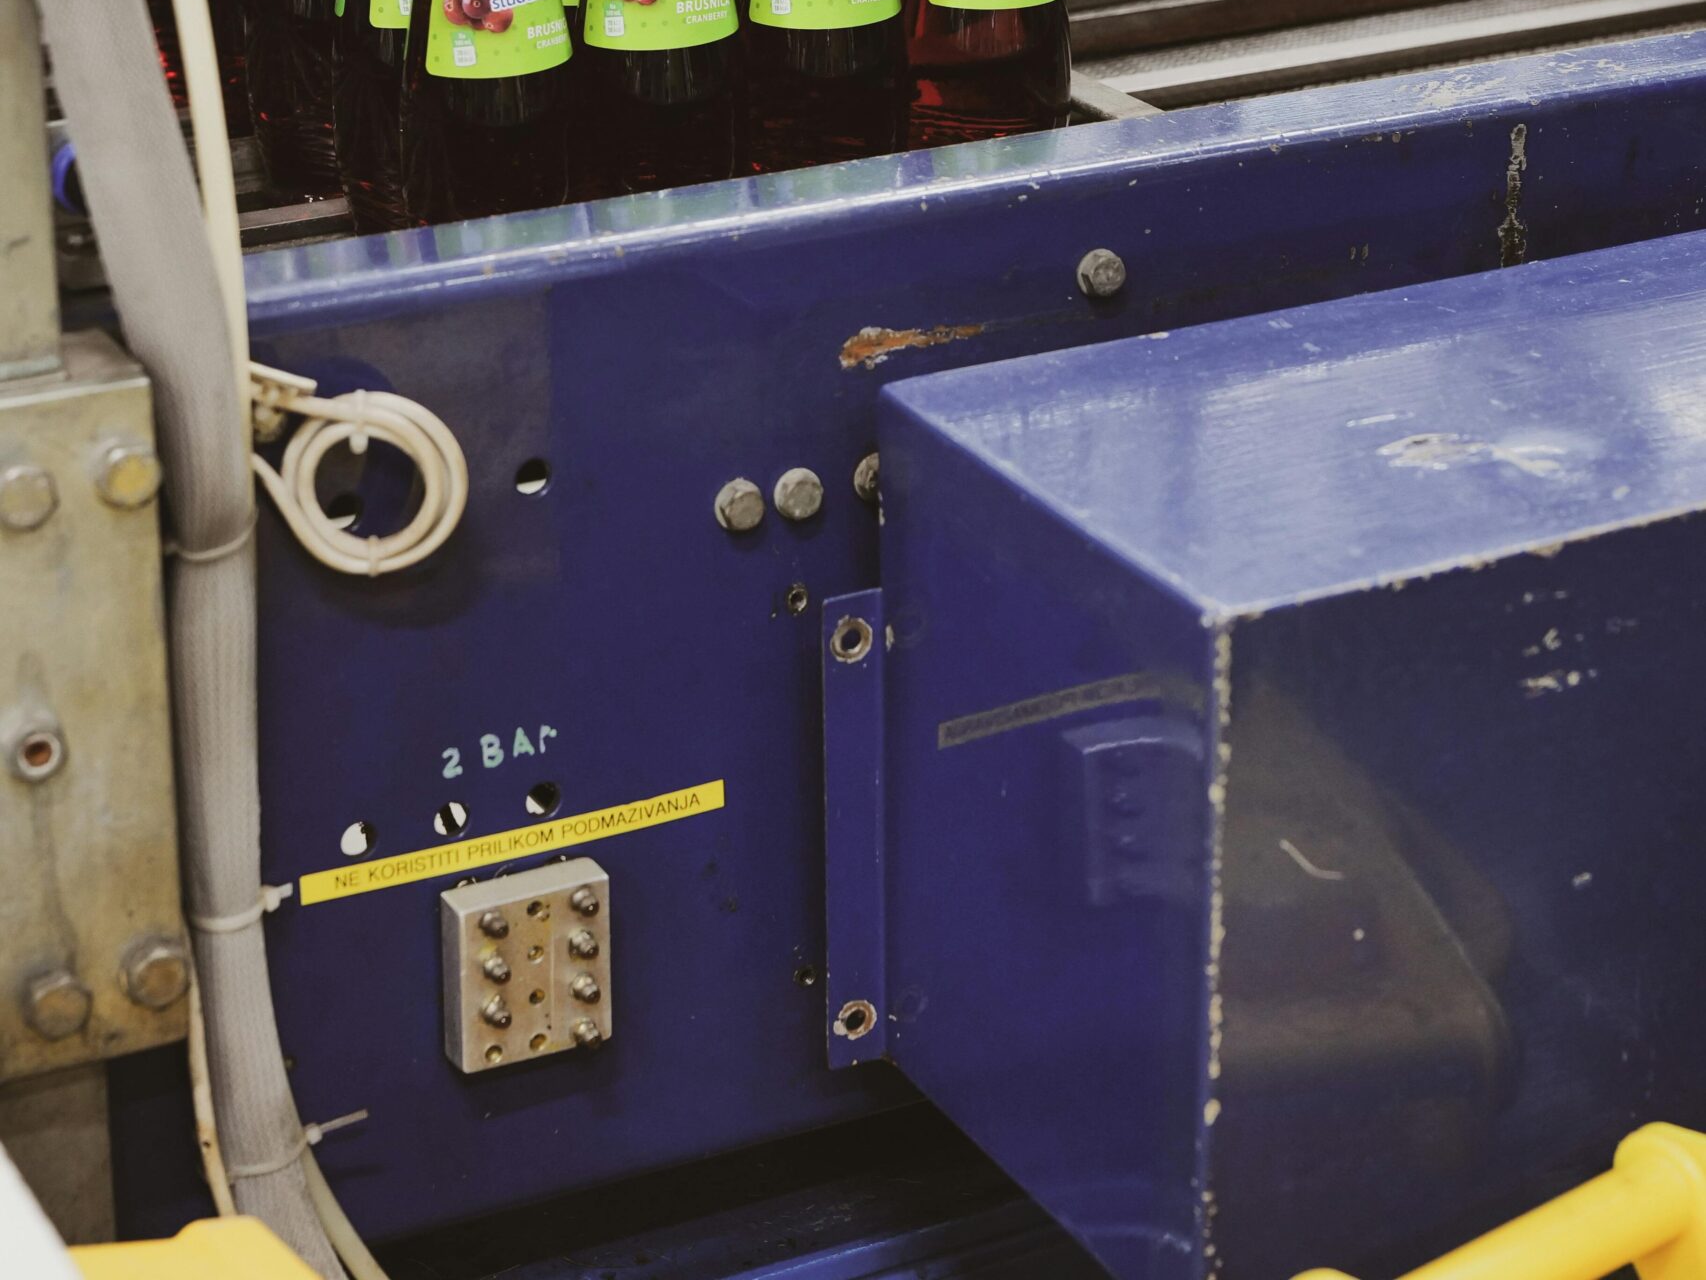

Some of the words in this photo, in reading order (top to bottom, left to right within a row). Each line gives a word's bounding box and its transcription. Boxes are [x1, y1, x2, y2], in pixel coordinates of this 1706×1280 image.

[441, 747, 463, 779] 2
[334, 874, 359, 890] NE
[368, 851, 460, 882] KORISTITI
[467, 827, 555, 860] PRILIKOM
[561, 792, 700, 839] PODMAZIVANJA
